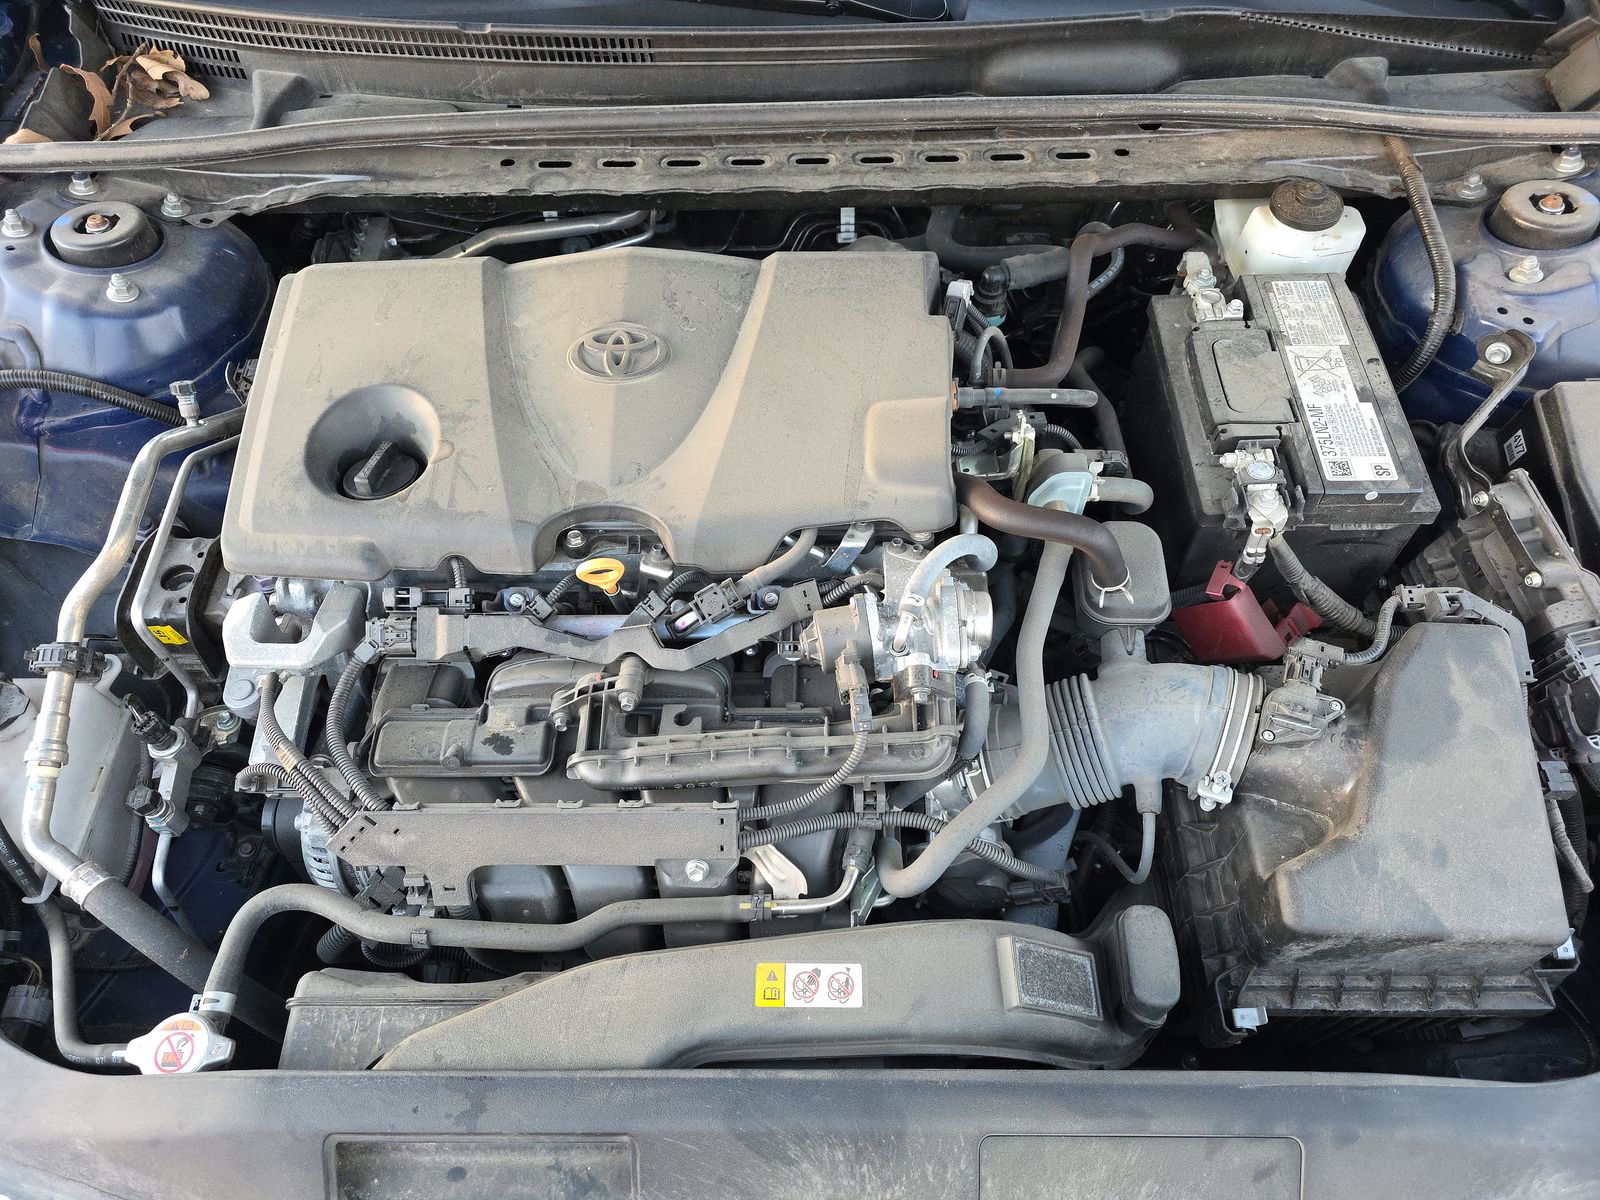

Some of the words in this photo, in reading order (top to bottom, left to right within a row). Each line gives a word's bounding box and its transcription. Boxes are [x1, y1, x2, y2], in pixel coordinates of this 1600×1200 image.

[1334, 358, 1344, 368] Pb
[1307, 404, 1337, 457] 375LN2-MF
[1514, 435, 1525, 454] 4V7
[1374, 465, 1391, 476] SP
